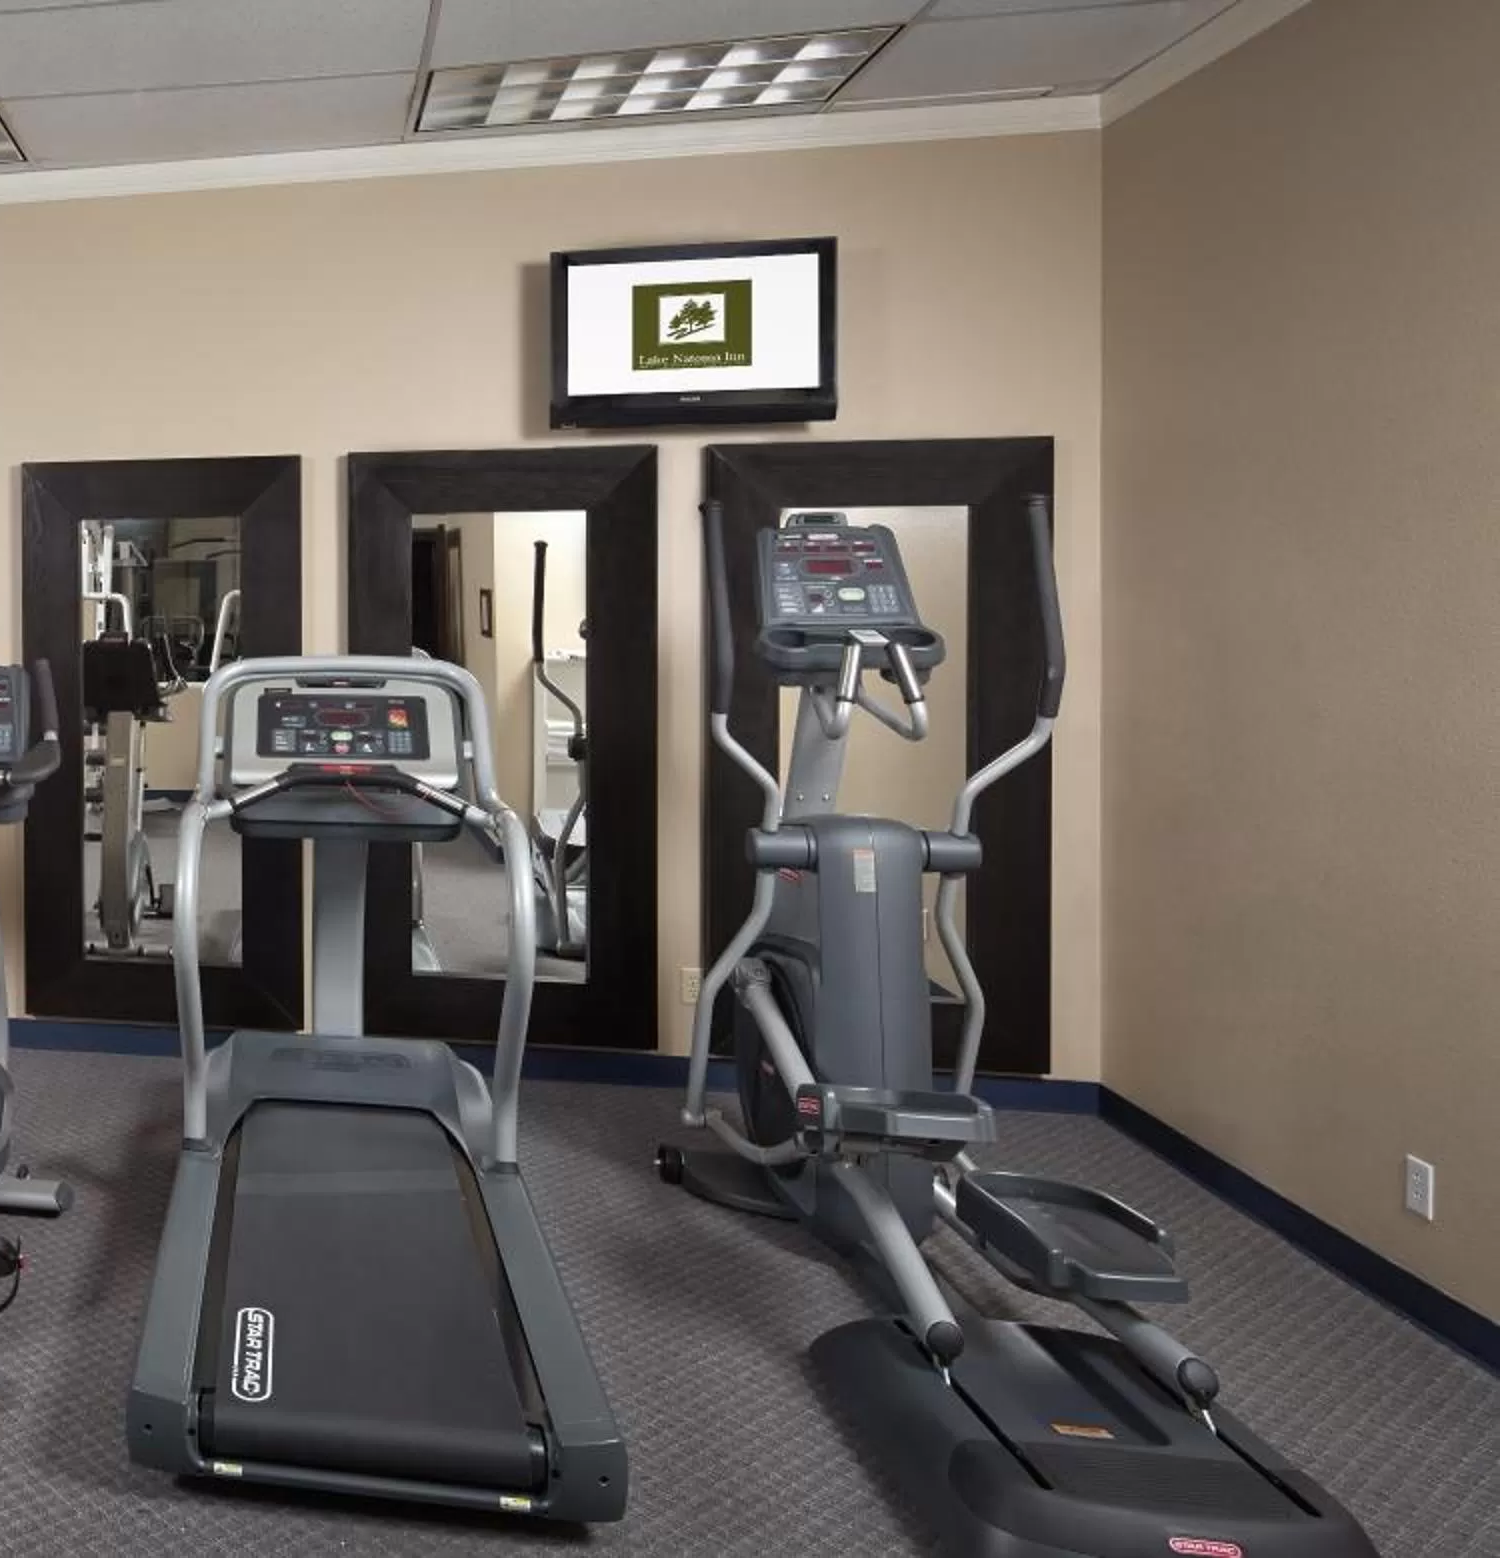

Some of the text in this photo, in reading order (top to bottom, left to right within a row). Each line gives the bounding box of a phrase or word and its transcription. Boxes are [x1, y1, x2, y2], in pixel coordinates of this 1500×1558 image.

[639, 354, 669, 365] Lake
[725, 351, 745, 361] Inn
[243, 1309, 264, 1394] STAR TRAC
[1174, 1541, 1203, 1550] STAR
